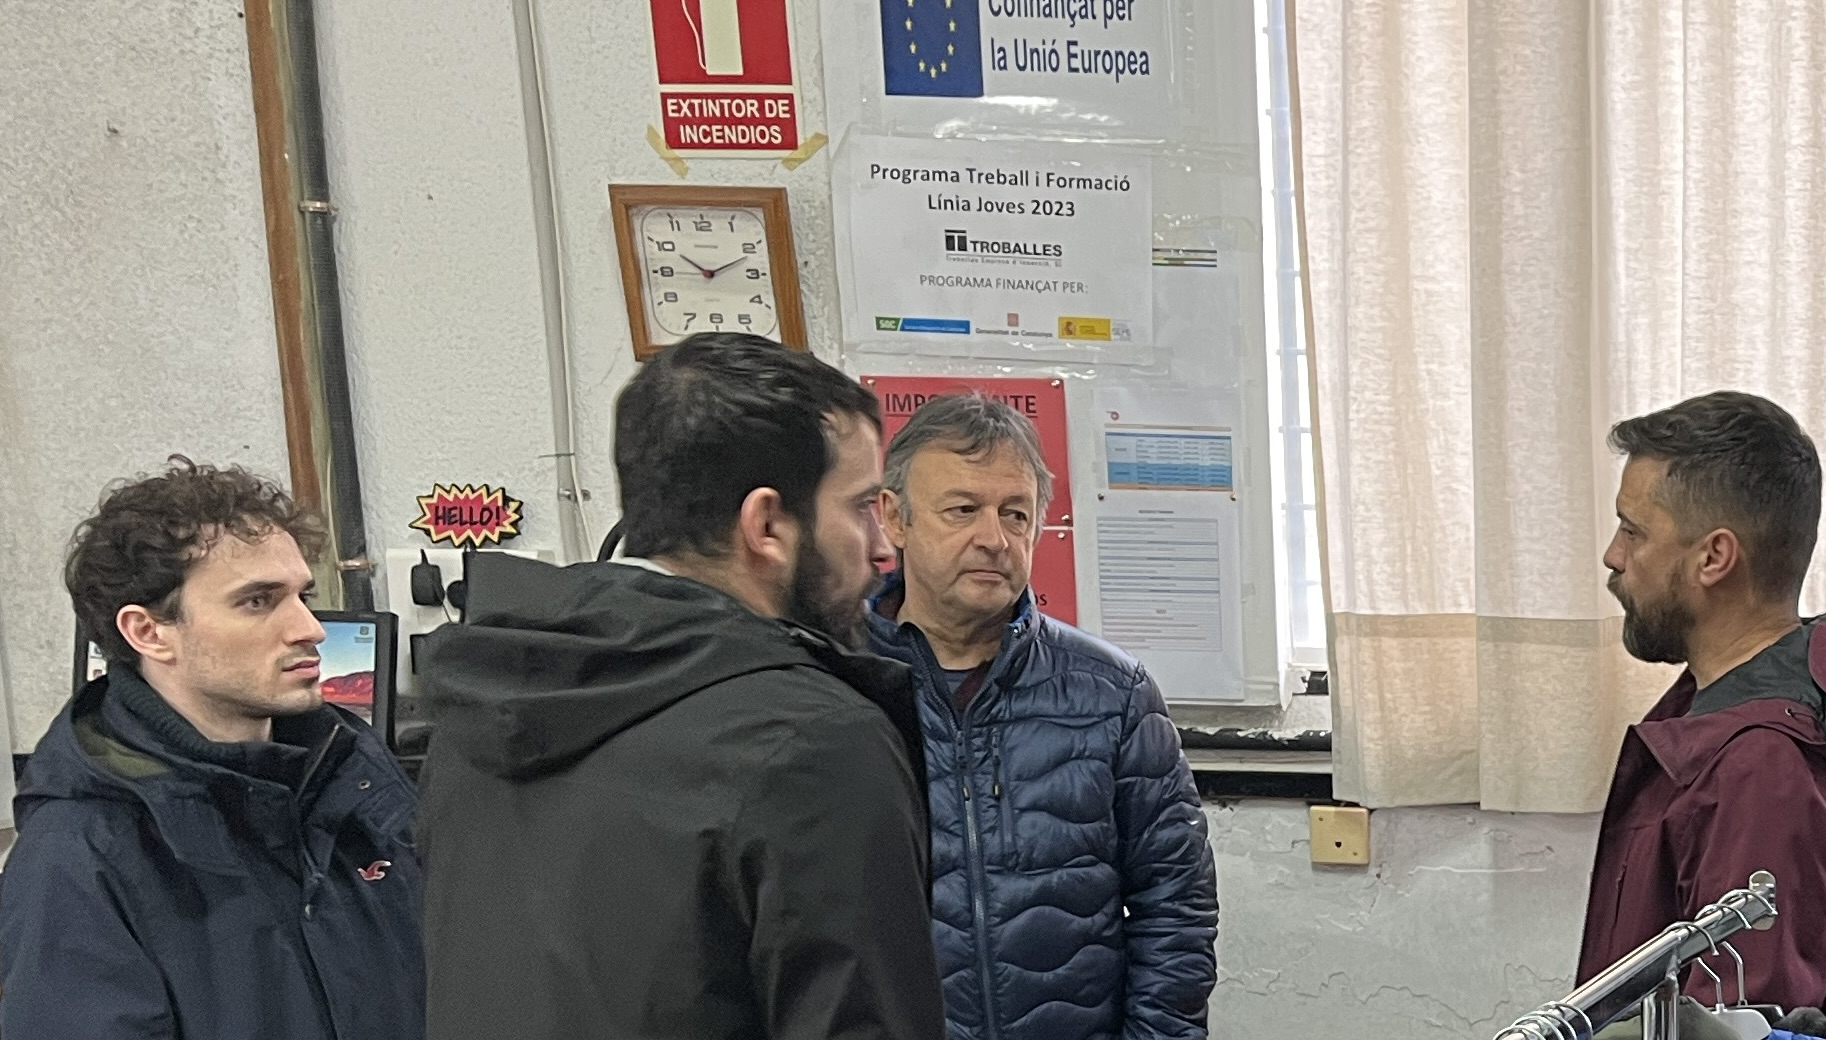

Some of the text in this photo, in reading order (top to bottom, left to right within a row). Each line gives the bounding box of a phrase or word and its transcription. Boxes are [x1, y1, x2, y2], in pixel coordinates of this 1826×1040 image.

[1103, 0, 1135, 29] per
[990, 37, 1151, 84] la Unió Europea
[666, 98, 791, 118] EXTINTOR DE
[680, 124, 782, 144] INCENDIOS
[870, 163, 961, 184] Programa
[965, 167, 1029, 187] Treball
[1046, 172, 1131, 192] Formació
[927, 193, 1076, 217] Línia Joves 2023
[692, 220, 713, 232] 12
[969, 240, 1063, 258] TROBALLES
[919, 274, 1089, 295] PROGRAMA FINANÇAT PER:
[434, 505, 501, 527] HELLO!
